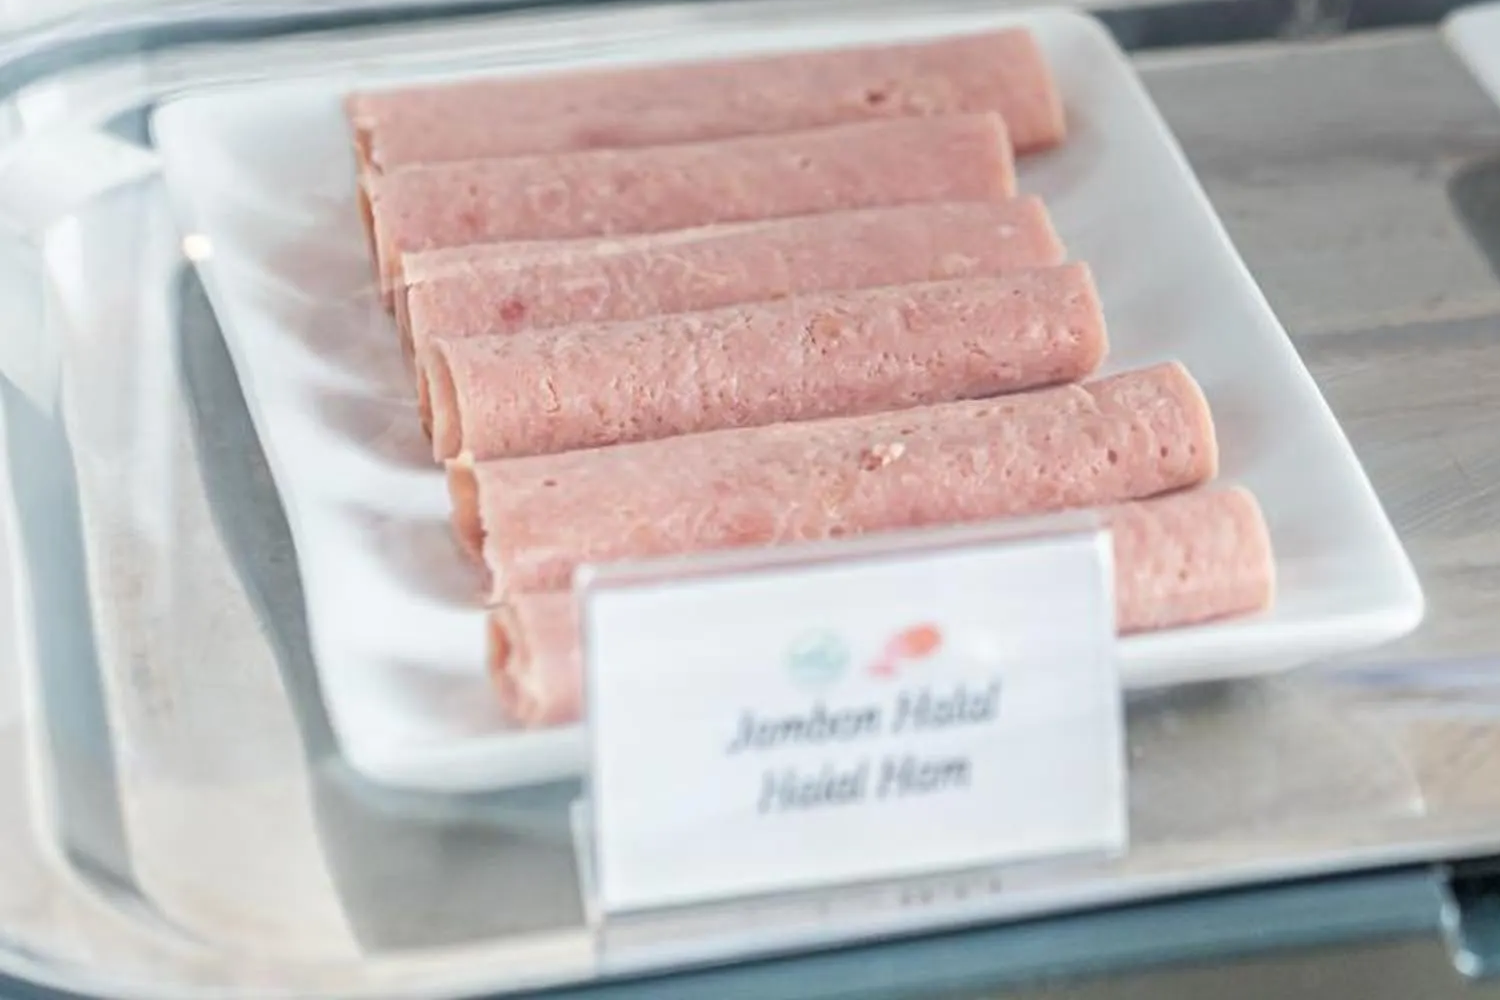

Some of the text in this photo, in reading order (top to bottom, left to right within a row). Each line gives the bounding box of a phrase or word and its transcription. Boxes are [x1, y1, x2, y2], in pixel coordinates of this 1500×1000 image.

[725, 676, 1001, 752] Jambon Halal
[757, 754, 971, 814] Halal Ham
